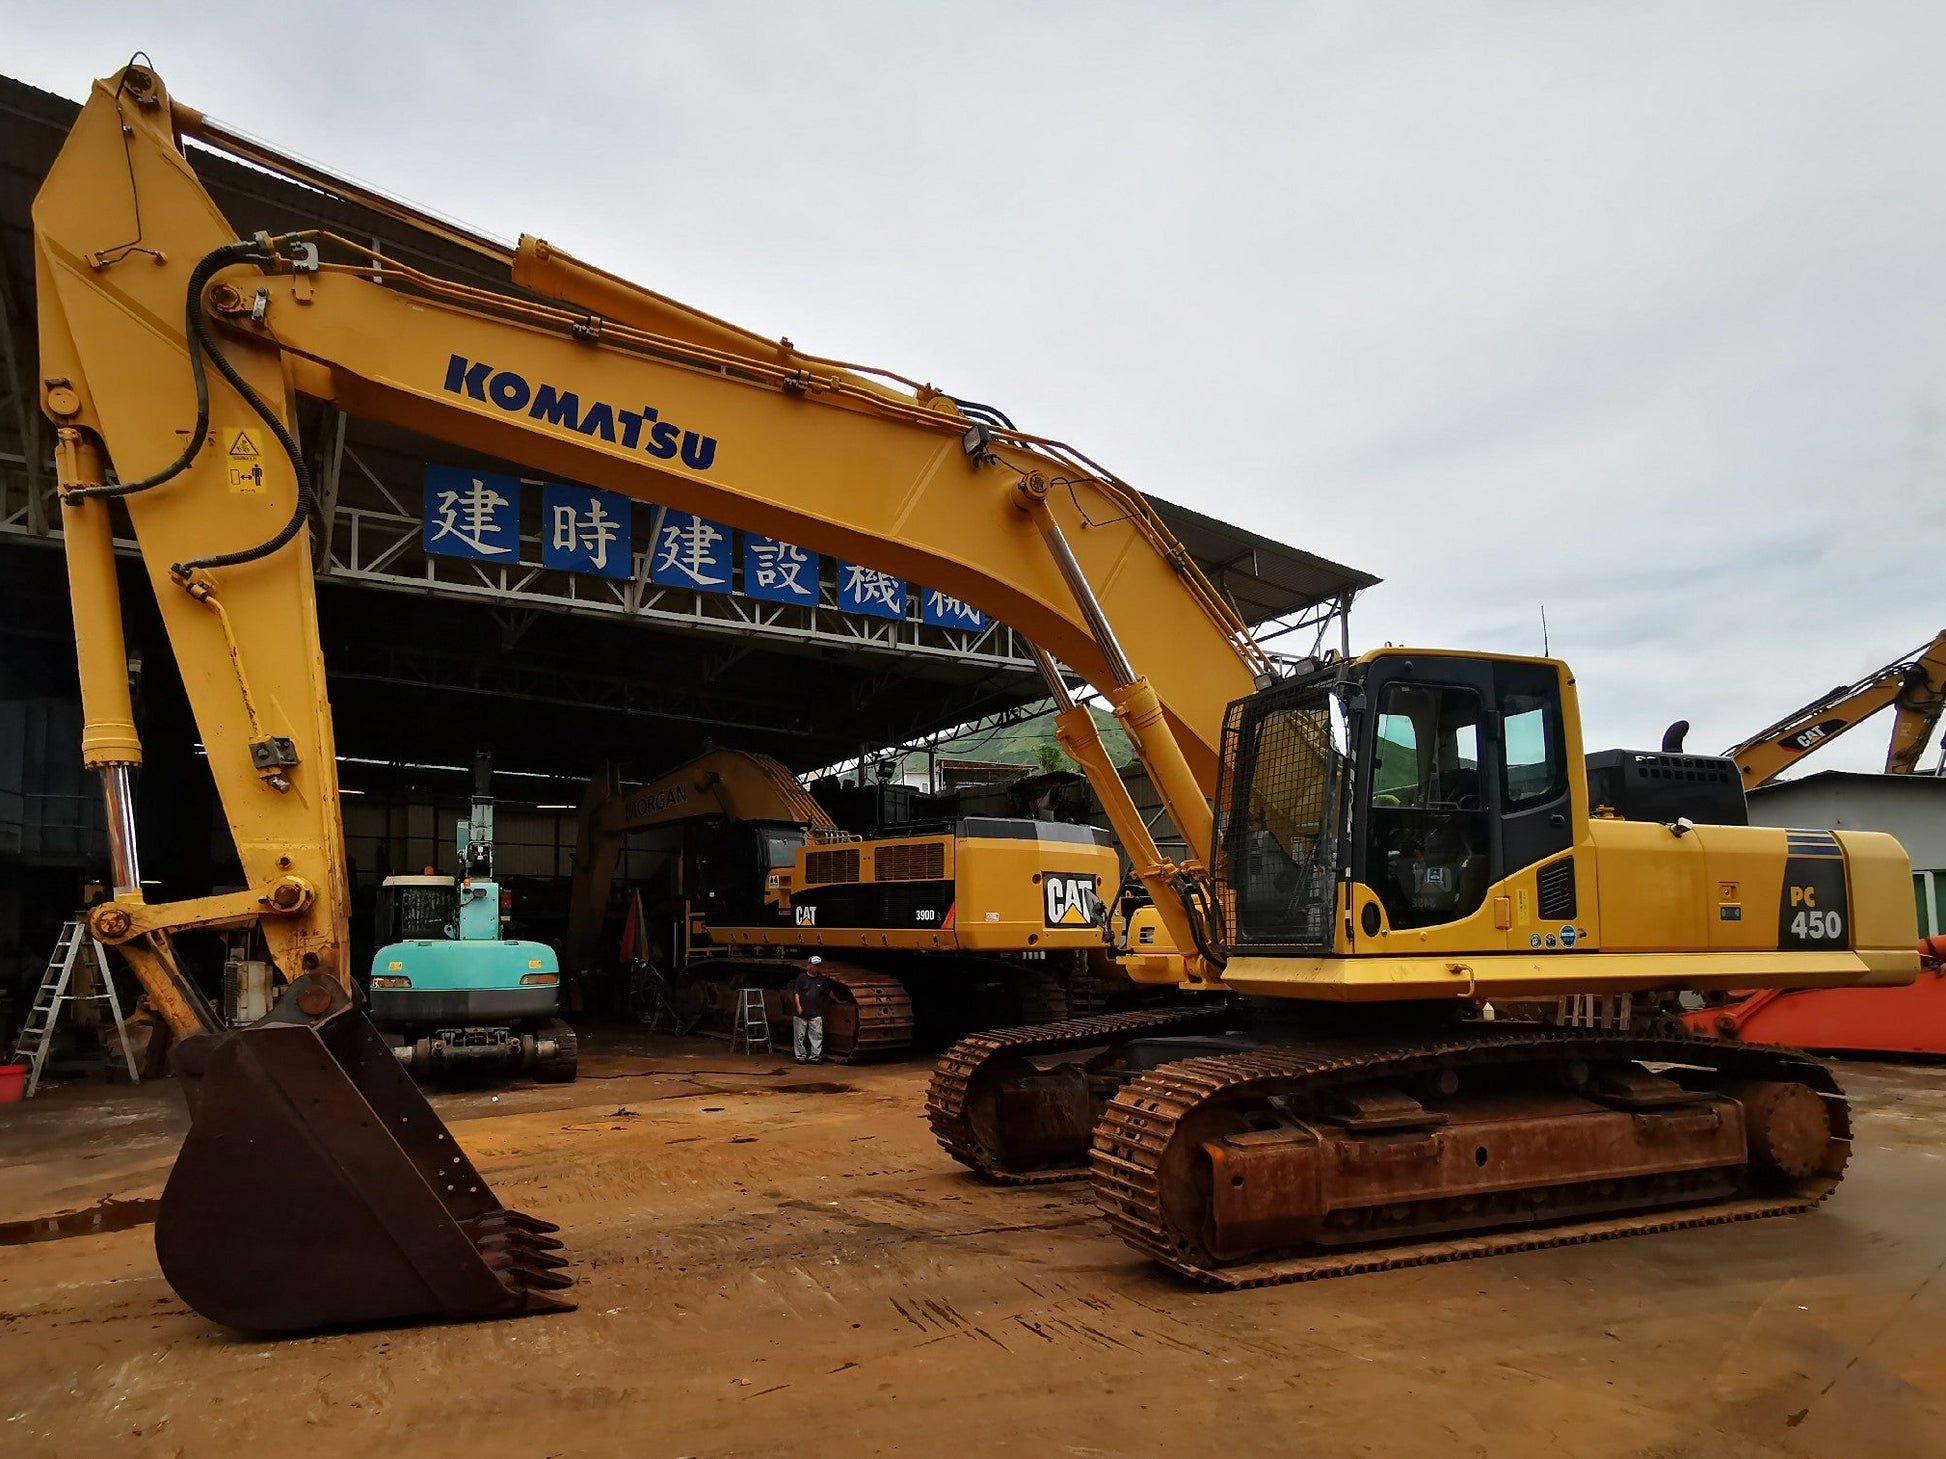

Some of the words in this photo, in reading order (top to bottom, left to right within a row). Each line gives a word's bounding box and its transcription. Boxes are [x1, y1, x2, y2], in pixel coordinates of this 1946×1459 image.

[444, 353, 718, 470] KOMATSU
[1797, 725, 1826, 747] CAT
[625, 783, 687, 823] MORGAN
[1047, 877, 1092, 924] CAT
[1790, 886, 1815, 907] PC
[796, 906, 817, 926] CAT
[915, 909, 935, 921] 390D
[1791, 910, 1842, 939] 450
